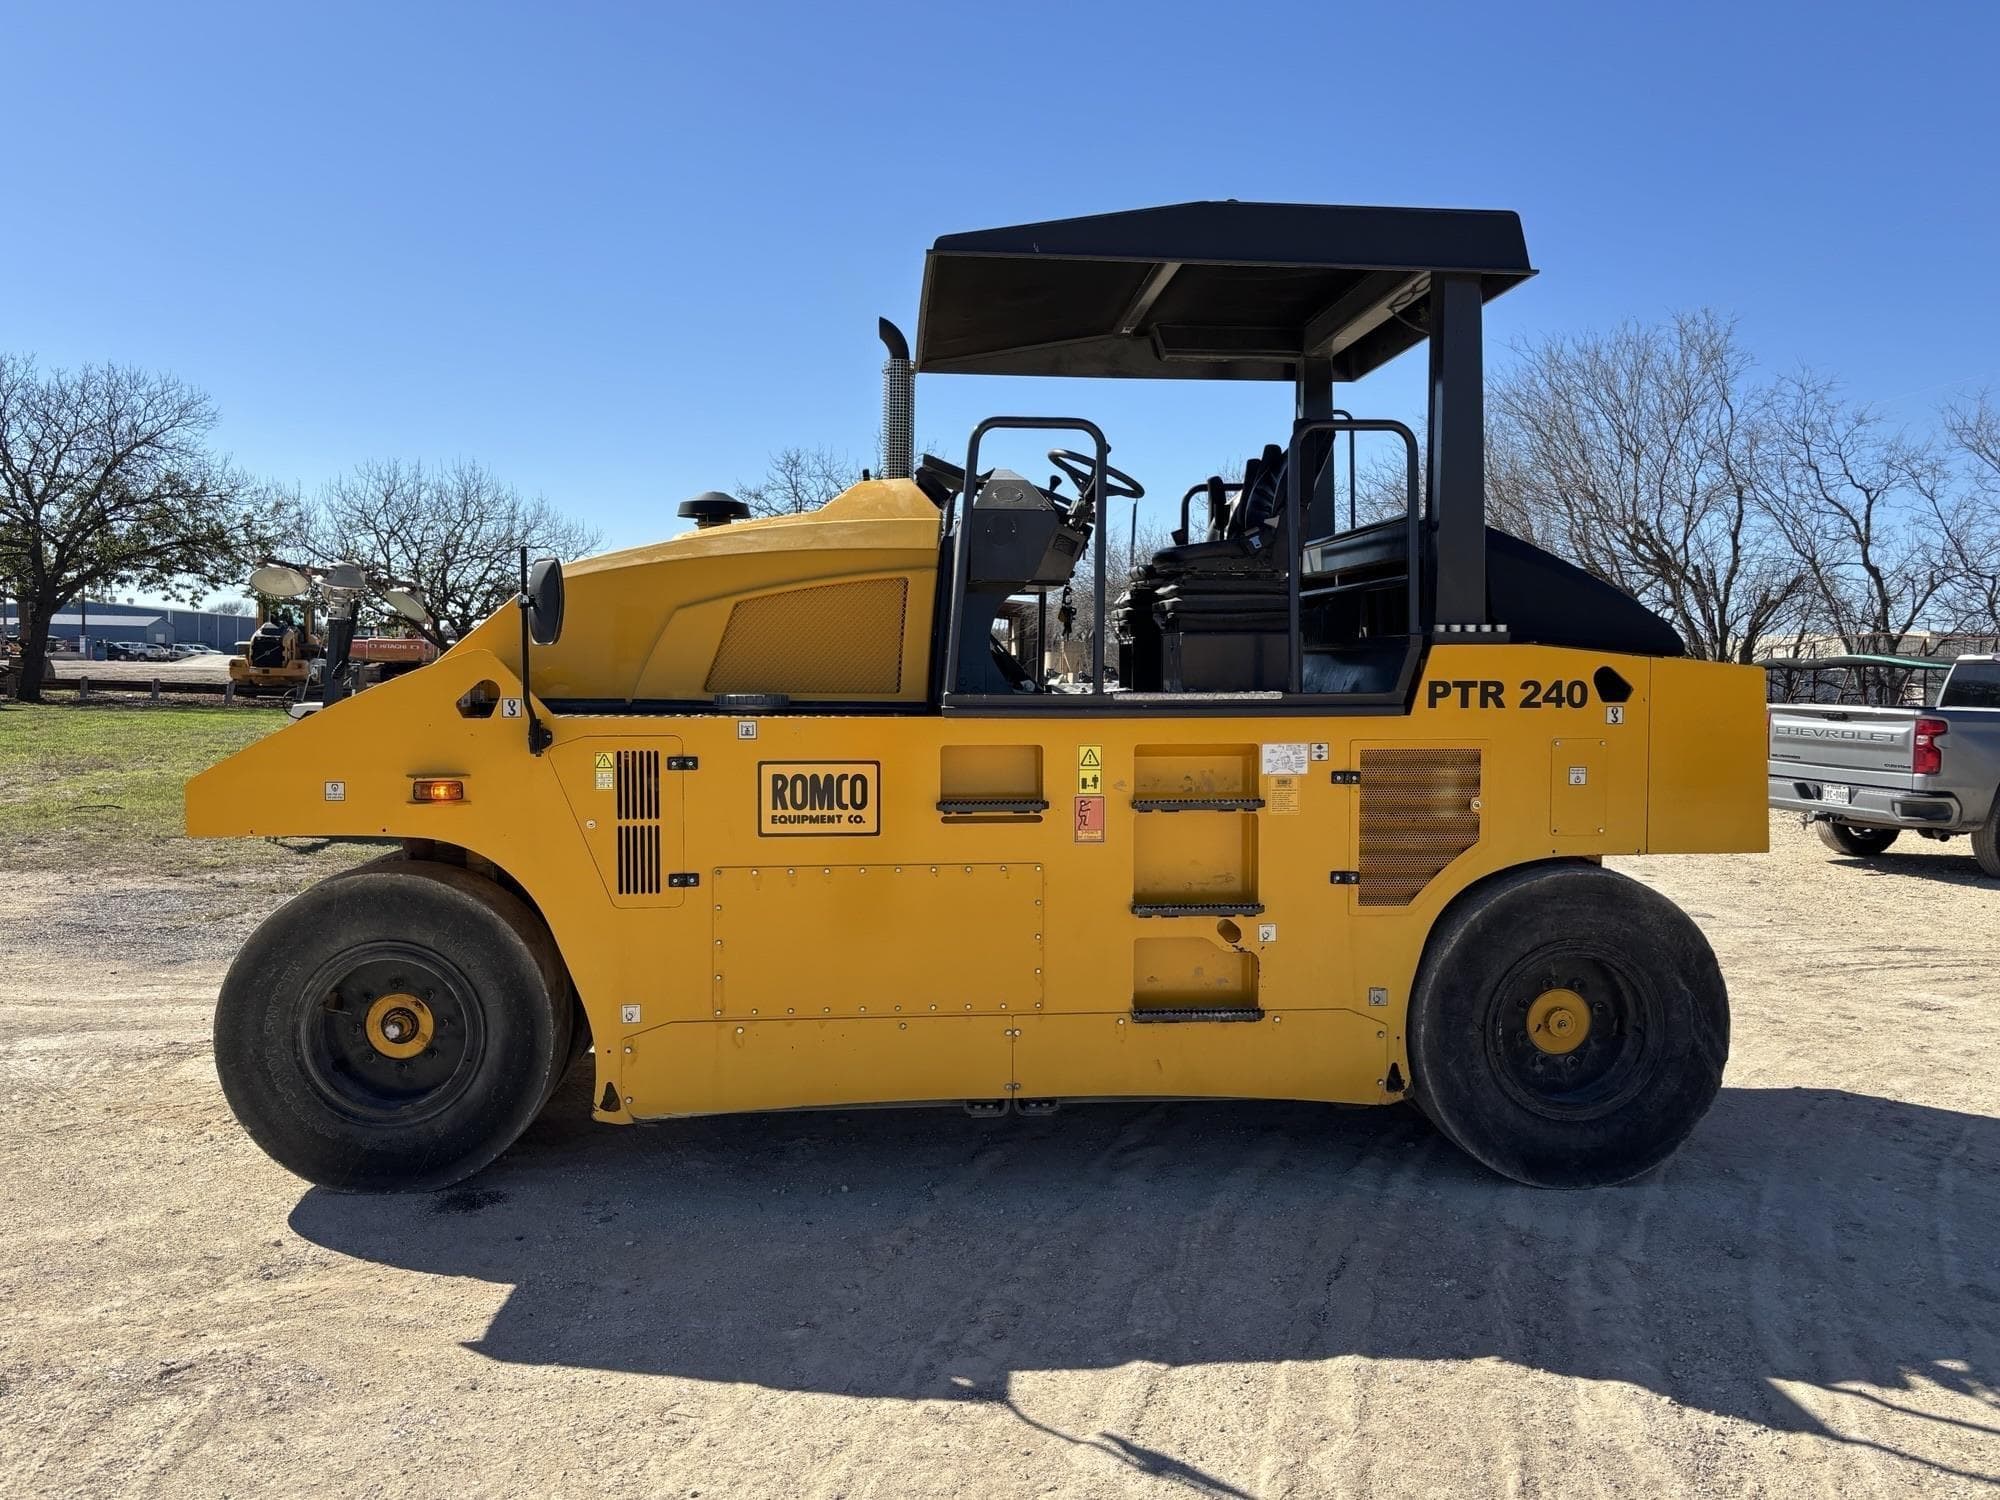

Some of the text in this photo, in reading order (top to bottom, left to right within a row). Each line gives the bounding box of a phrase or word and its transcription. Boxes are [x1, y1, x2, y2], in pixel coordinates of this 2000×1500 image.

[1427, 680, 1588, 709] PTR 240
[1775, 727, 1901, 743] CHEVROLET
[771, 773, 868, 811] ROMCO
[771, 814, 866, 824] EQUIPMENT CO.
